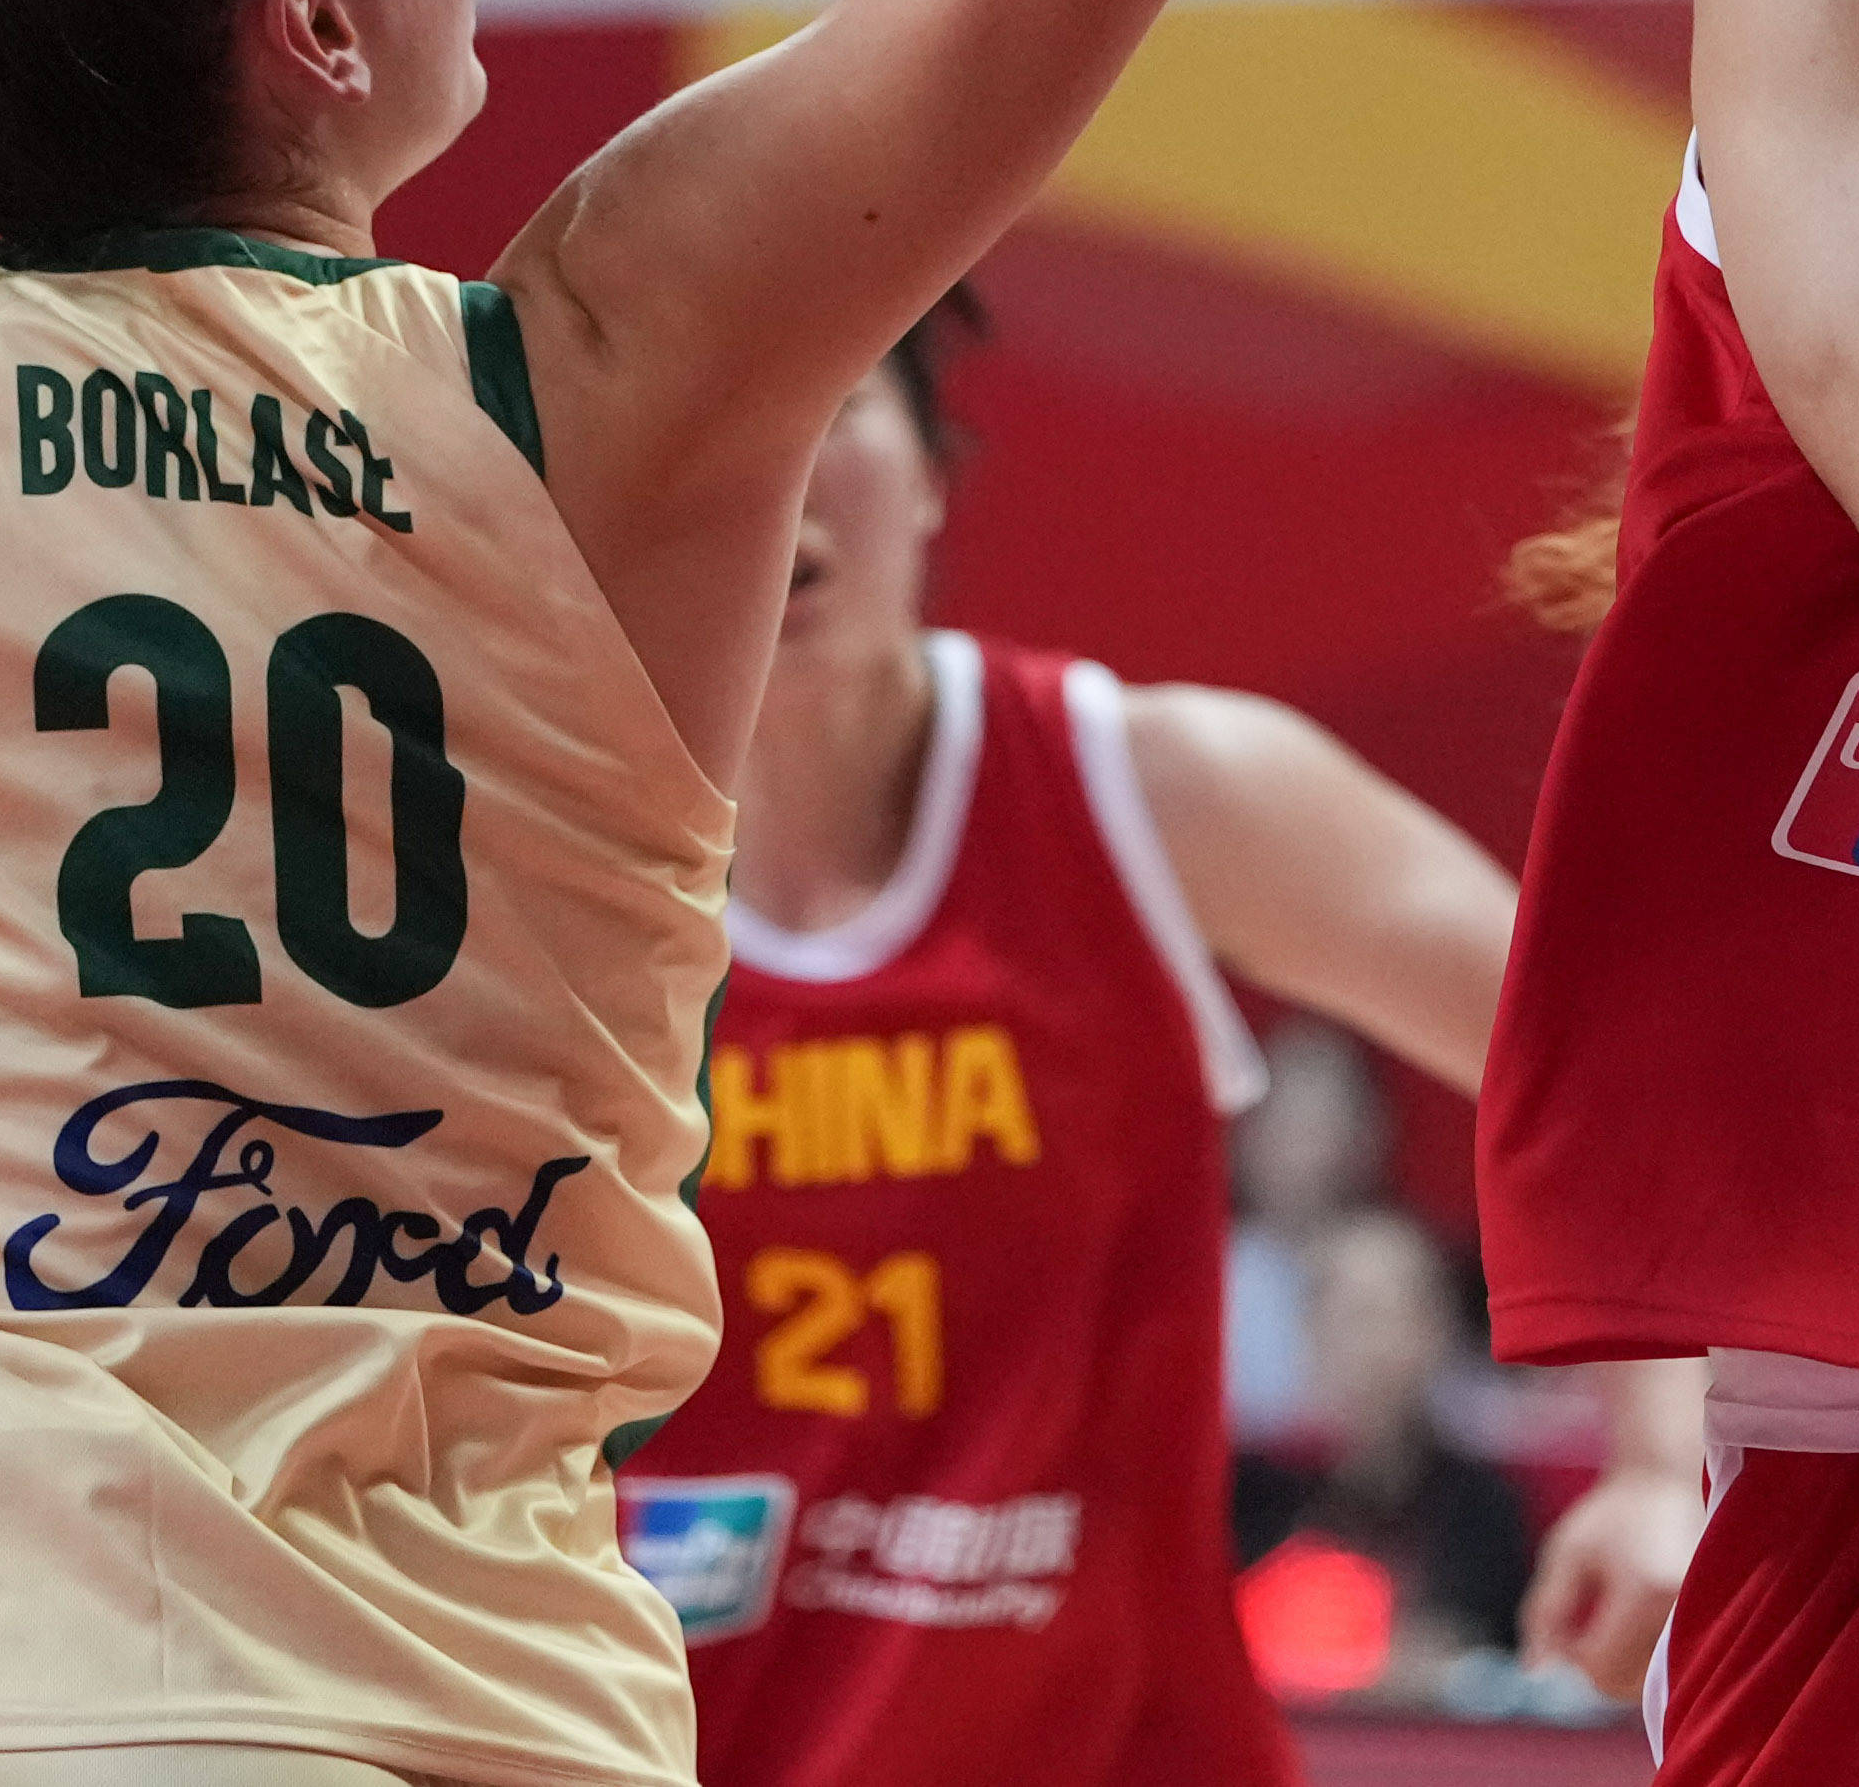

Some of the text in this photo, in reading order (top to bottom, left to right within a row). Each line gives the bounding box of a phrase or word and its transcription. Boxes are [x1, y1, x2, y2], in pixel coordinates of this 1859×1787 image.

[17, 364, 413, 533] BORLASE
[34, 592, 469, 1009] 20
[699, 1026, 1041, 1190] HINA
[4, 1079, 591, 1315] Ford
[746, 1246, 943, 1419] 21
